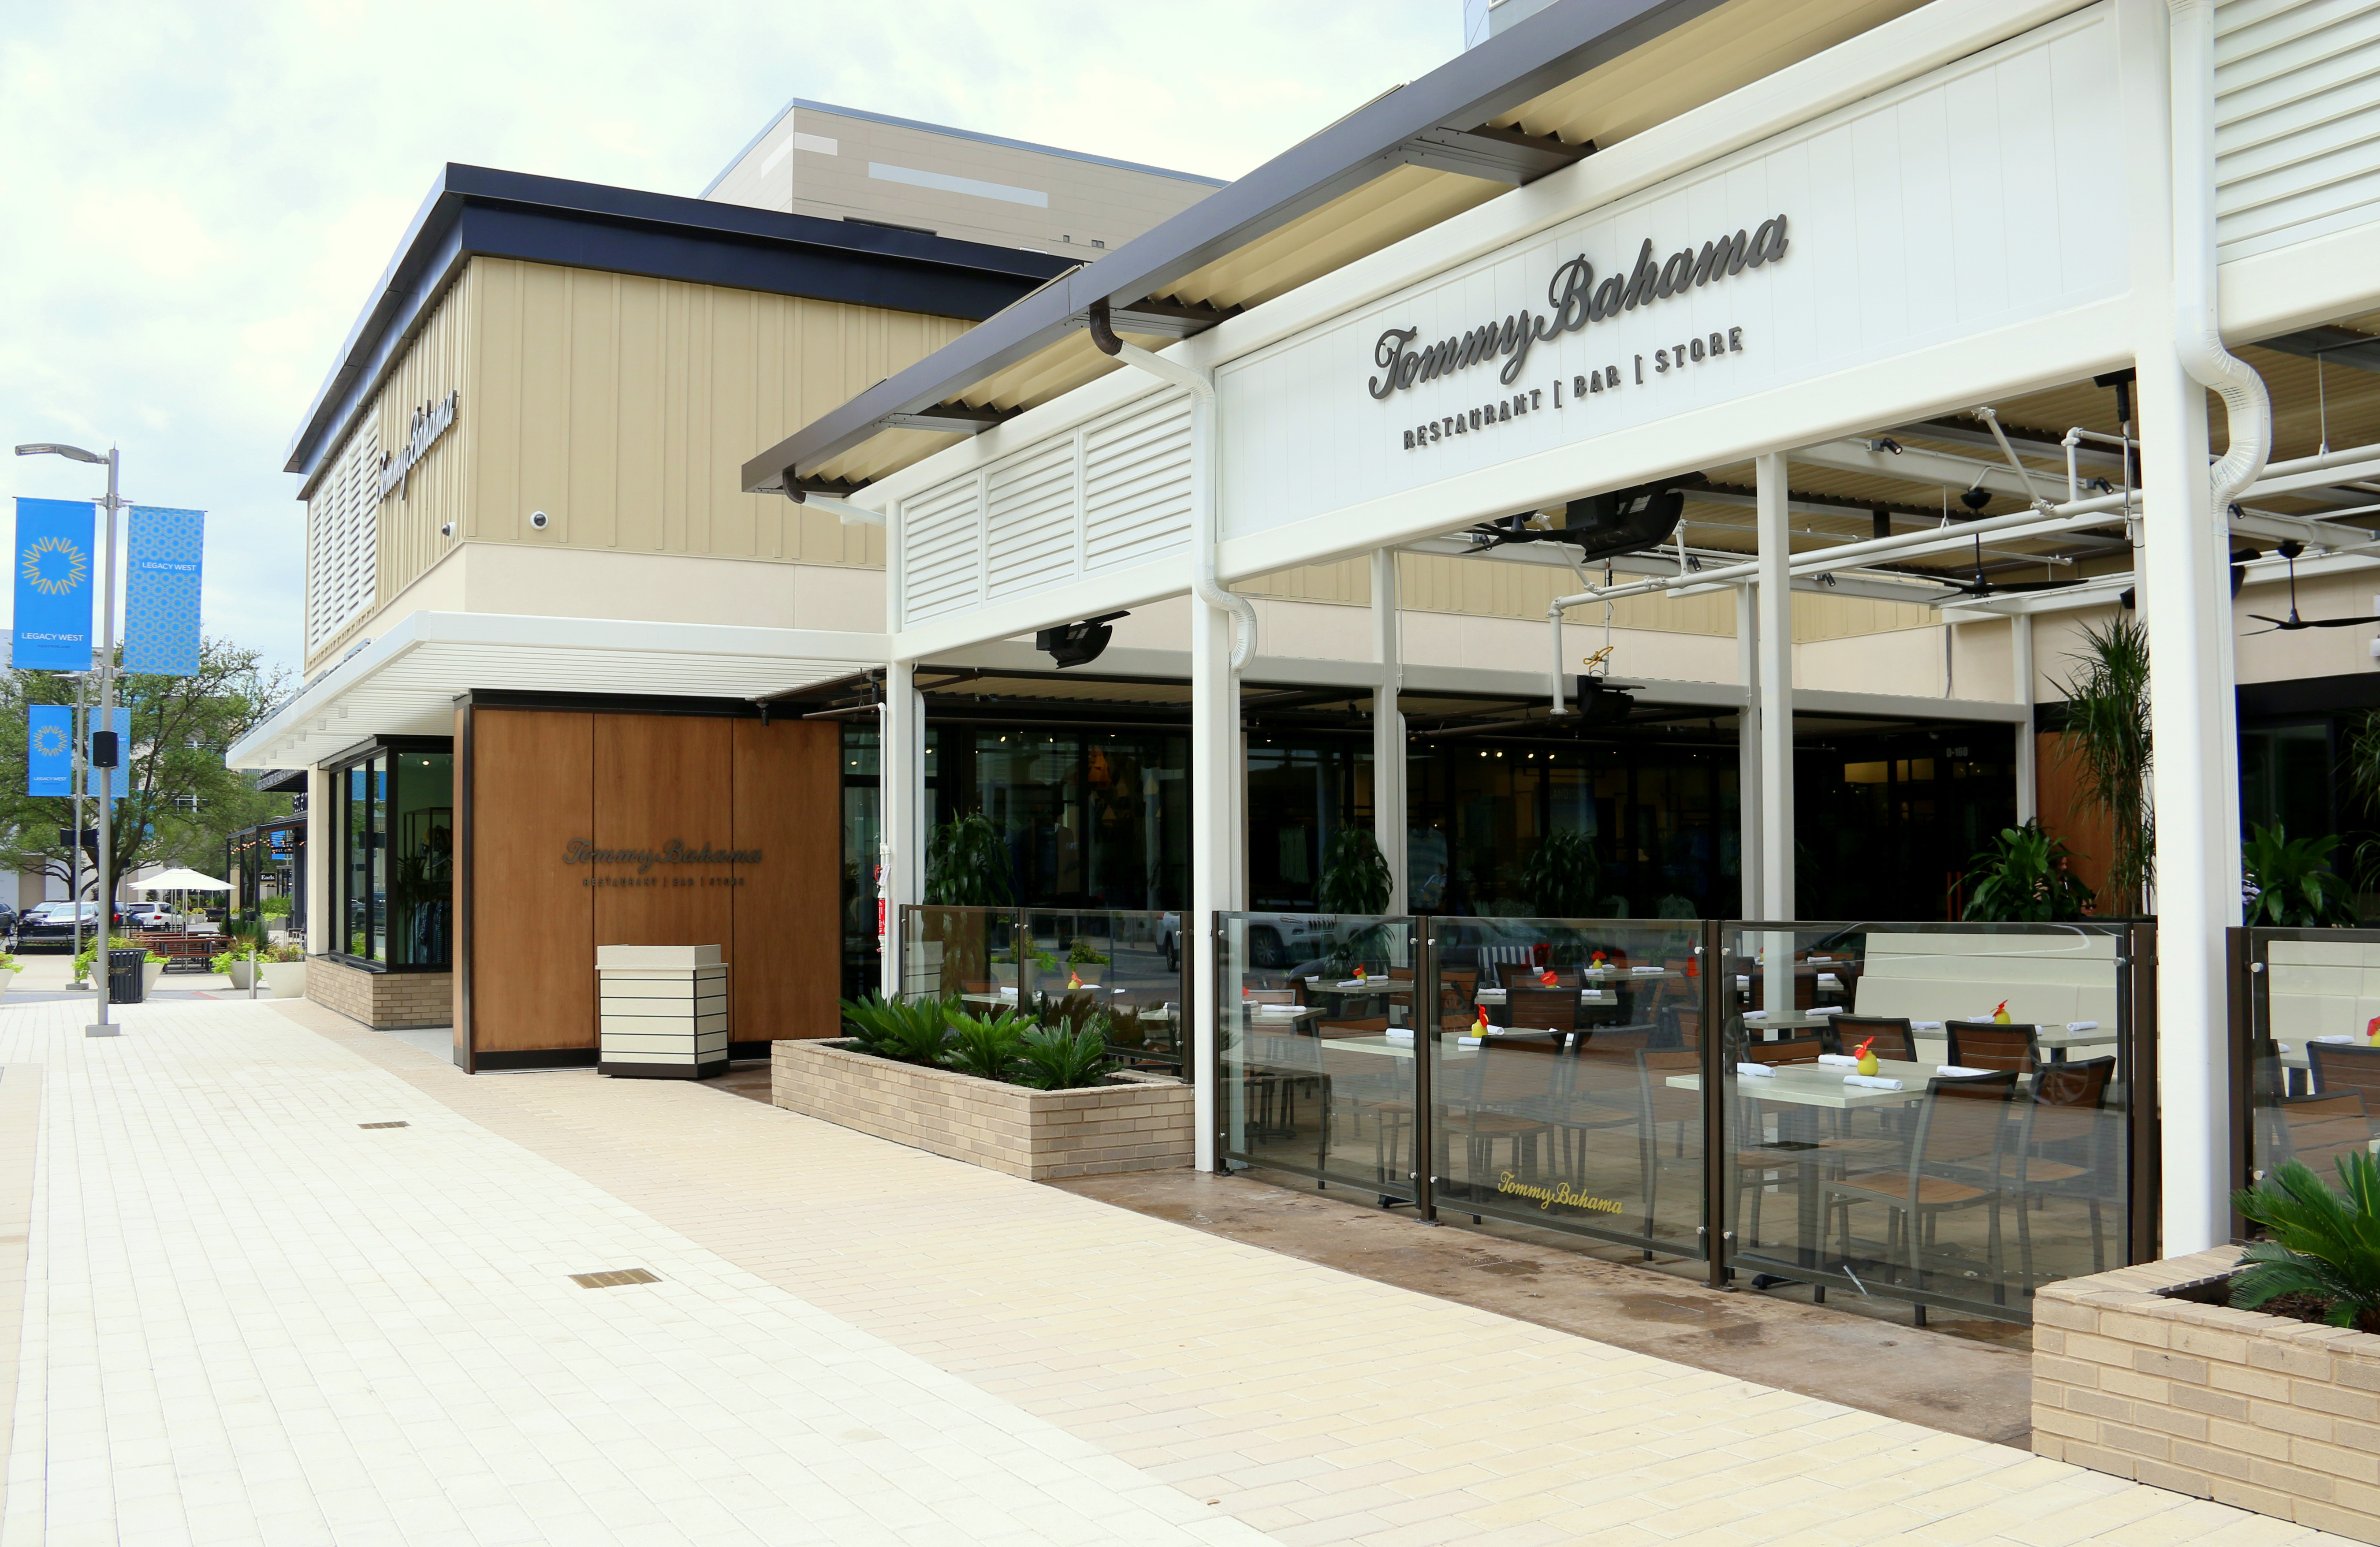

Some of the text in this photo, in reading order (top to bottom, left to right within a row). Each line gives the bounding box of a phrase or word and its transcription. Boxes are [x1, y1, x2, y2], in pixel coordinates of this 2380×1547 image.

[1369, 214, 1789, 399] Tommy Bahama
[1404, 389, 1541, 450] RESTAURANT
[1574, 365, 1620, 398] BAR
[1655, 326, 1743, 373] STORE
[1946, 746, 1968, 758] D-160
[562, 838, 763, 873] Tommy Bahama
[583, 877, 657, 886] RESTAURANT
[673, 877, 694, 886] BAR
[709, 877, 745, 886] STORE
[1497, 1171, 1623, 1214] Tommy Bahama
